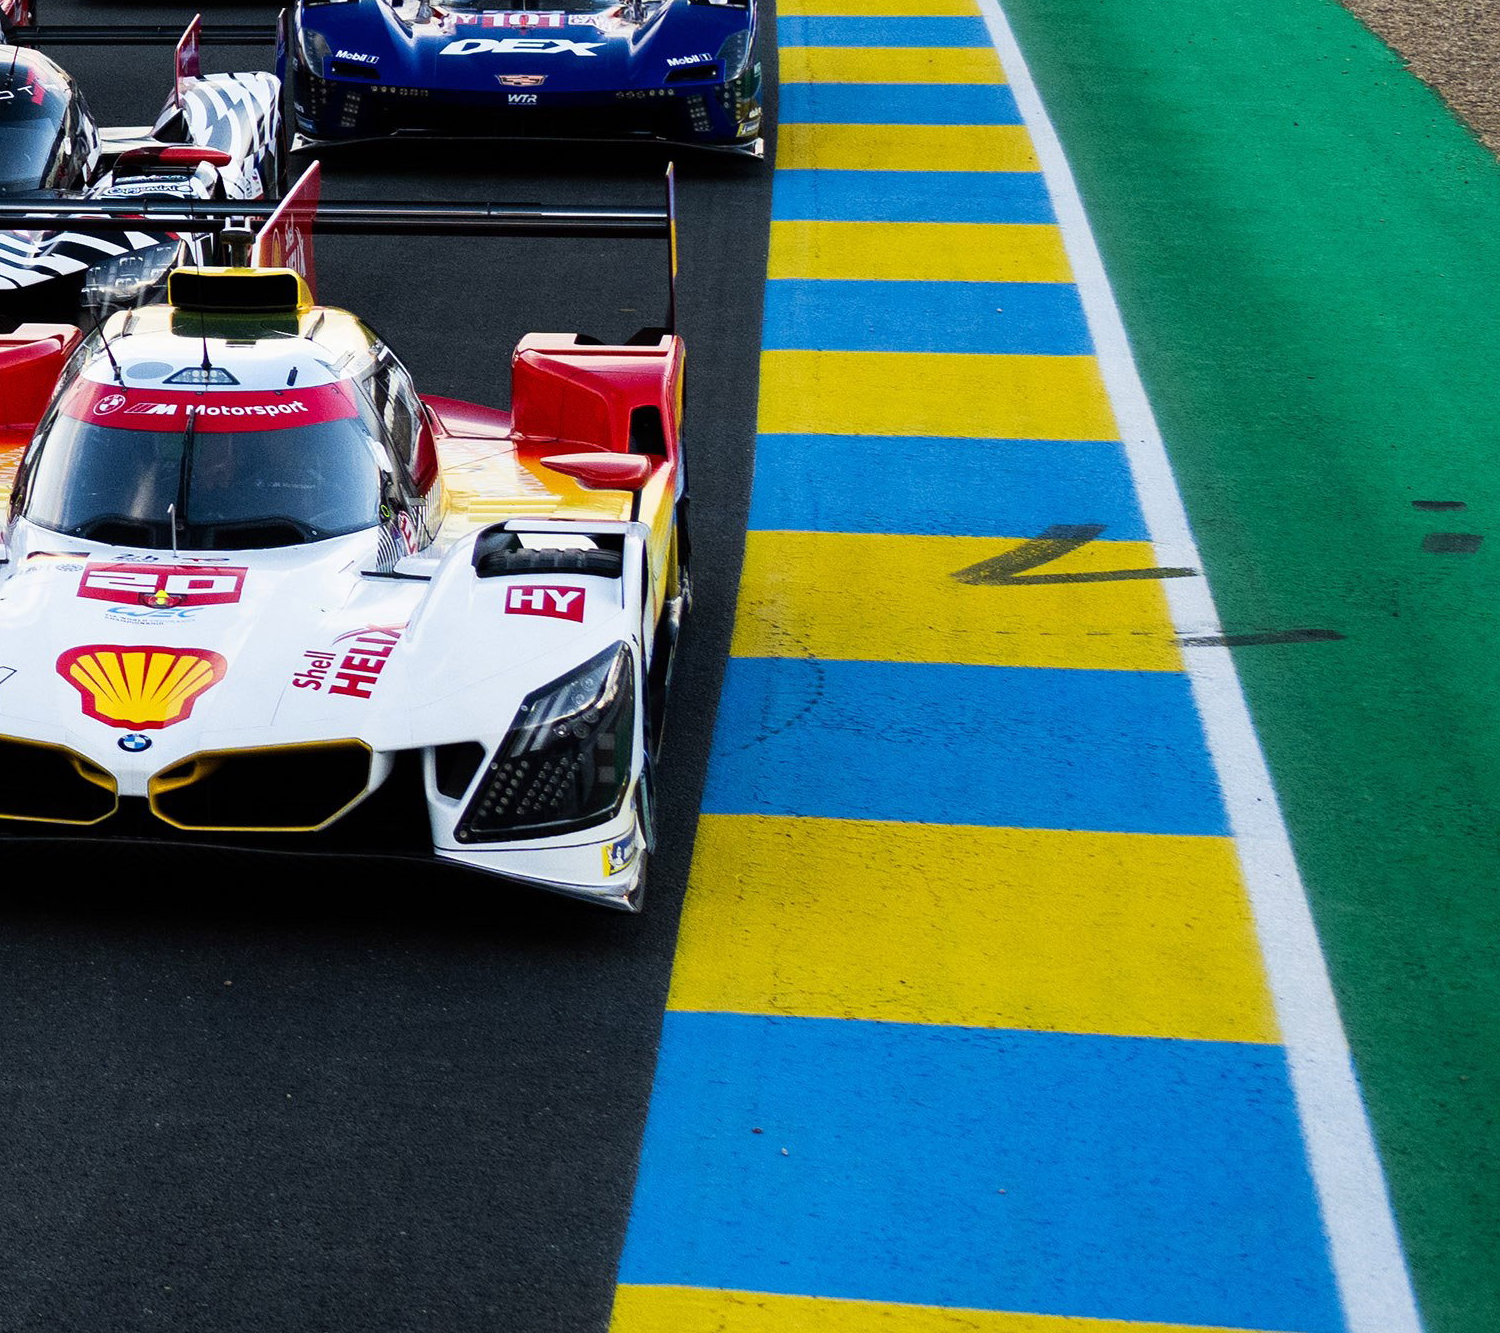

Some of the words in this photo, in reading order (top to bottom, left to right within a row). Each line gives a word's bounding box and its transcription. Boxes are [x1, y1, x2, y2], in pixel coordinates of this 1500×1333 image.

[440, 39, 606, 56] DEX
[507, 94, 537, 103] WTR
[85, 570, 237, 595] 20
[509, 586, 582, 616] HY
[293, 650, 336, 692] Shell
[329, 624, 406, 699] HELIX
